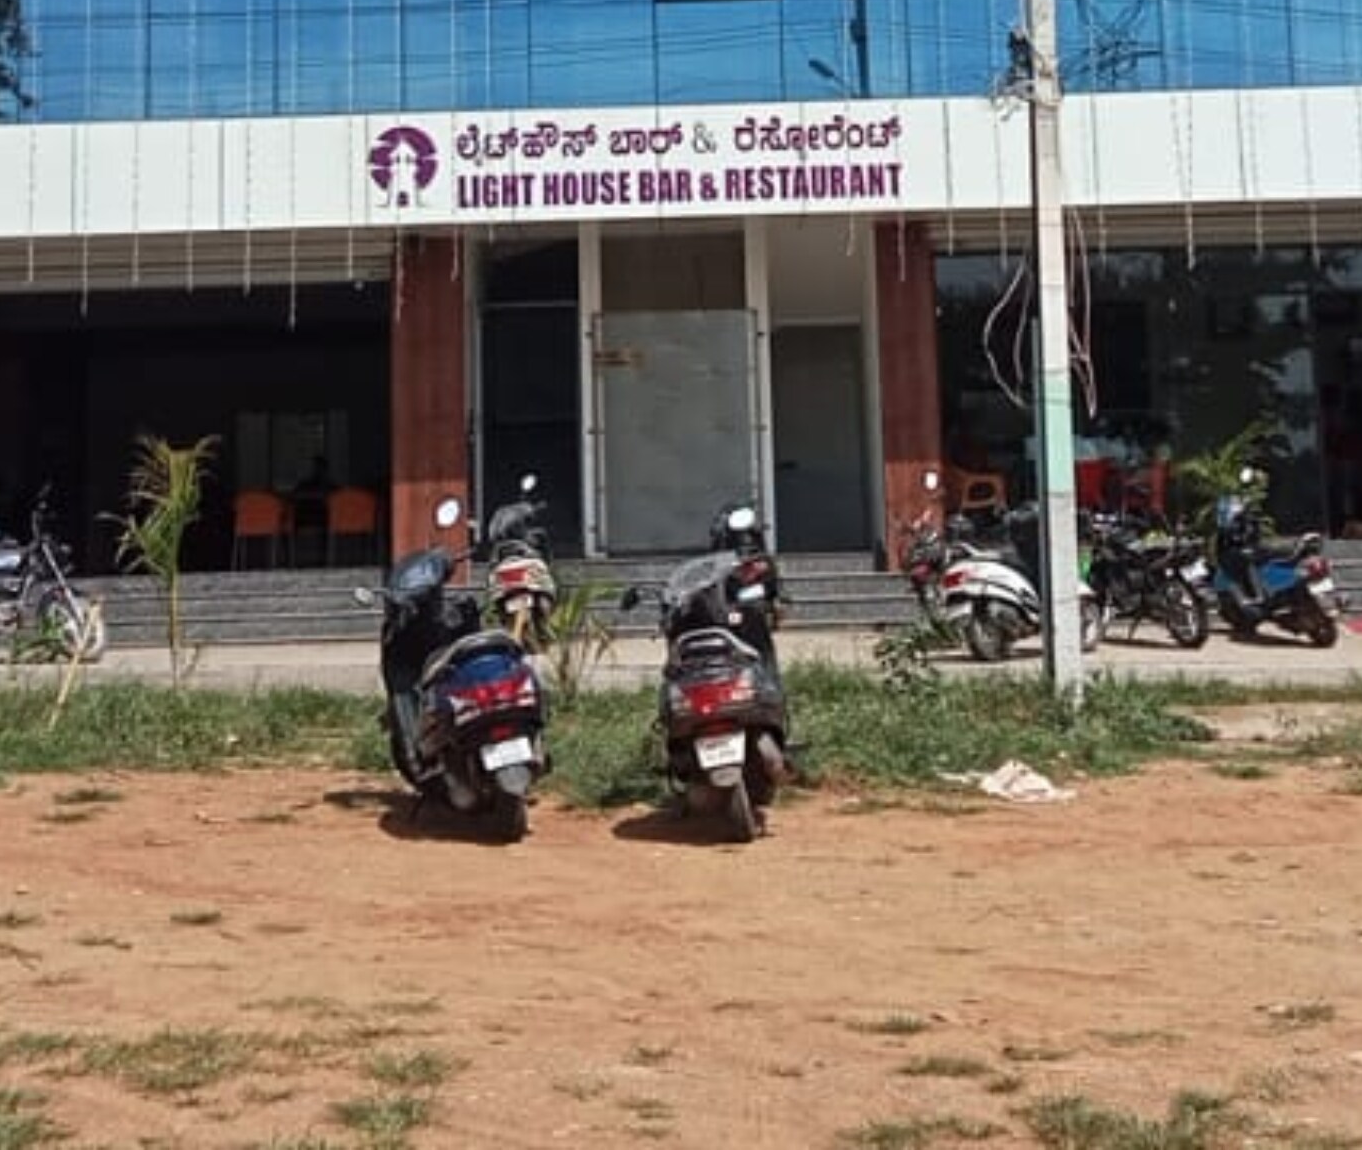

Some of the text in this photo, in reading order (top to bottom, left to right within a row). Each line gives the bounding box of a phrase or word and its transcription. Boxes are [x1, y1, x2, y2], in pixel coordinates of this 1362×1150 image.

[609, 123, 684, 156] ಬಾರ್
[691, 122, 717, 154] &
[457, 163, 901, 209] LIGHT HOUSE BAR & RESTAURANT
